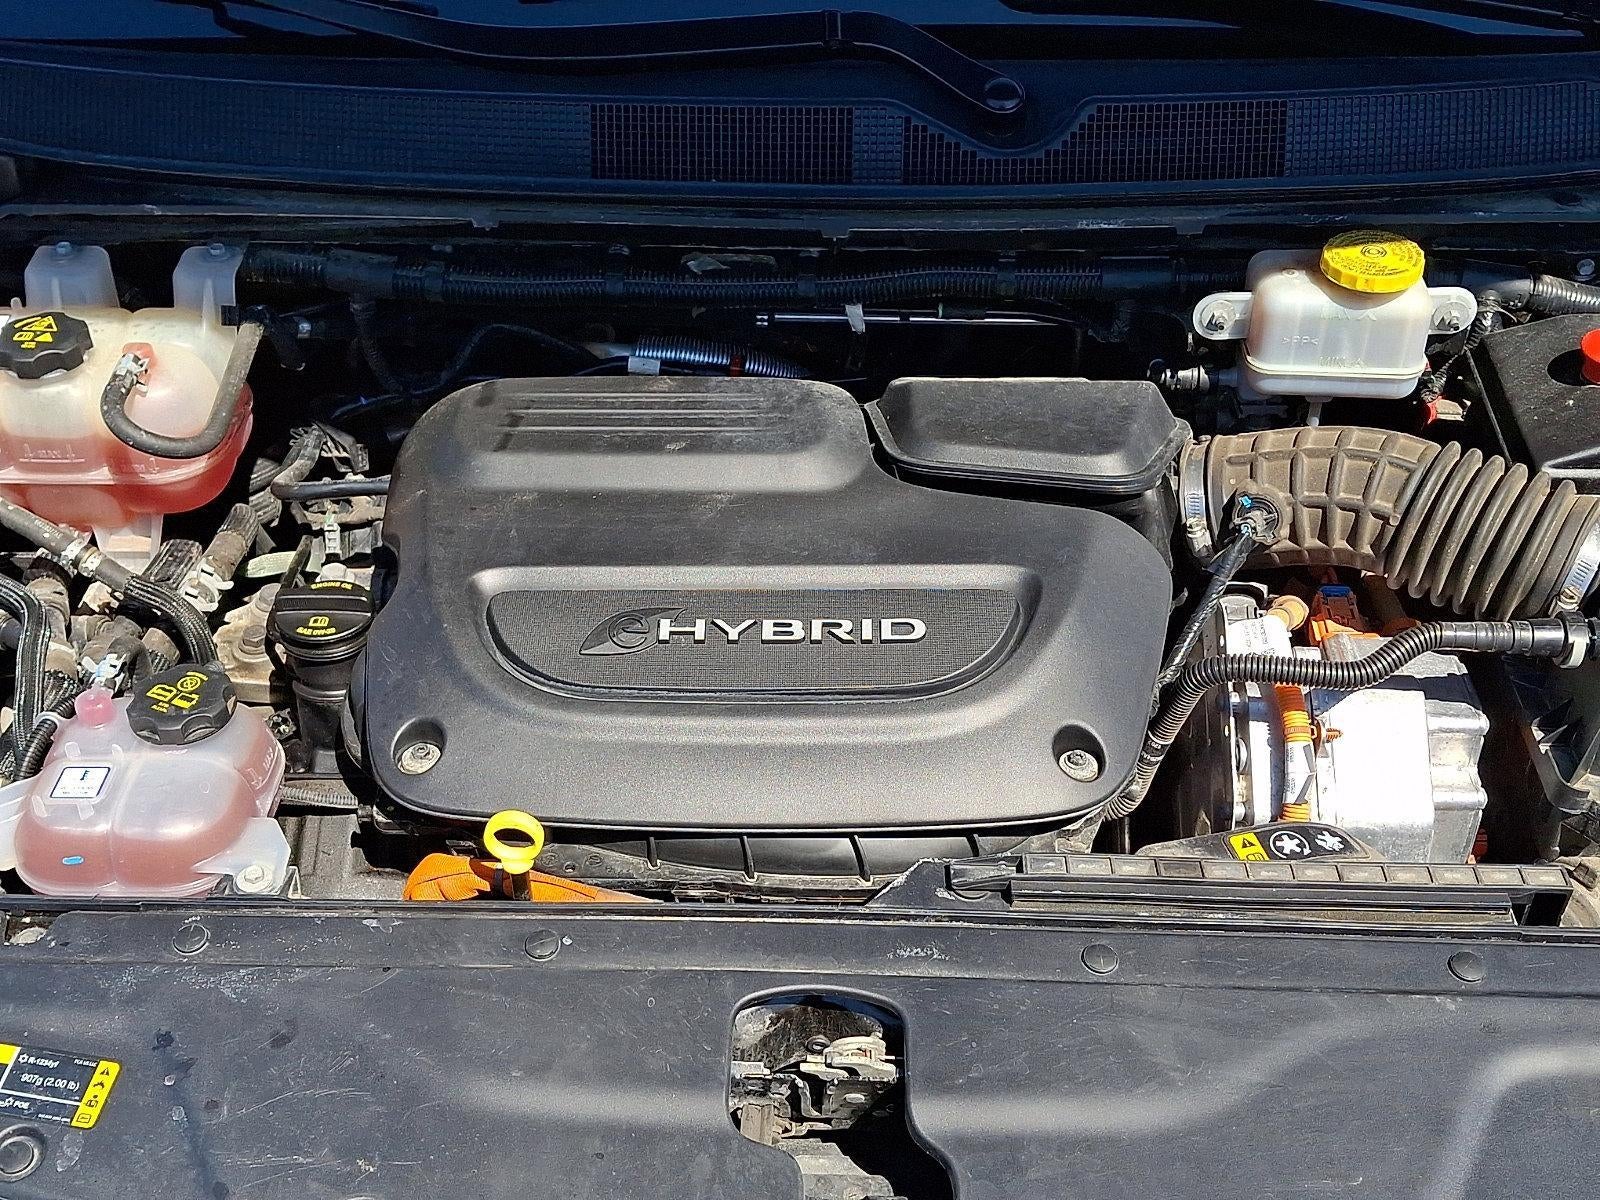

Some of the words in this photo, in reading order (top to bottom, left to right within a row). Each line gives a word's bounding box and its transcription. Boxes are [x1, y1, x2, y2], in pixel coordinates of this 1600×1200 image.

[310, 581, 340, 590] ENGINE
[20, 1073, 44, 1086] 907g
[44, 1076, 66, 1090] (2.00
[66, 1079, 80, 1092] lb)
